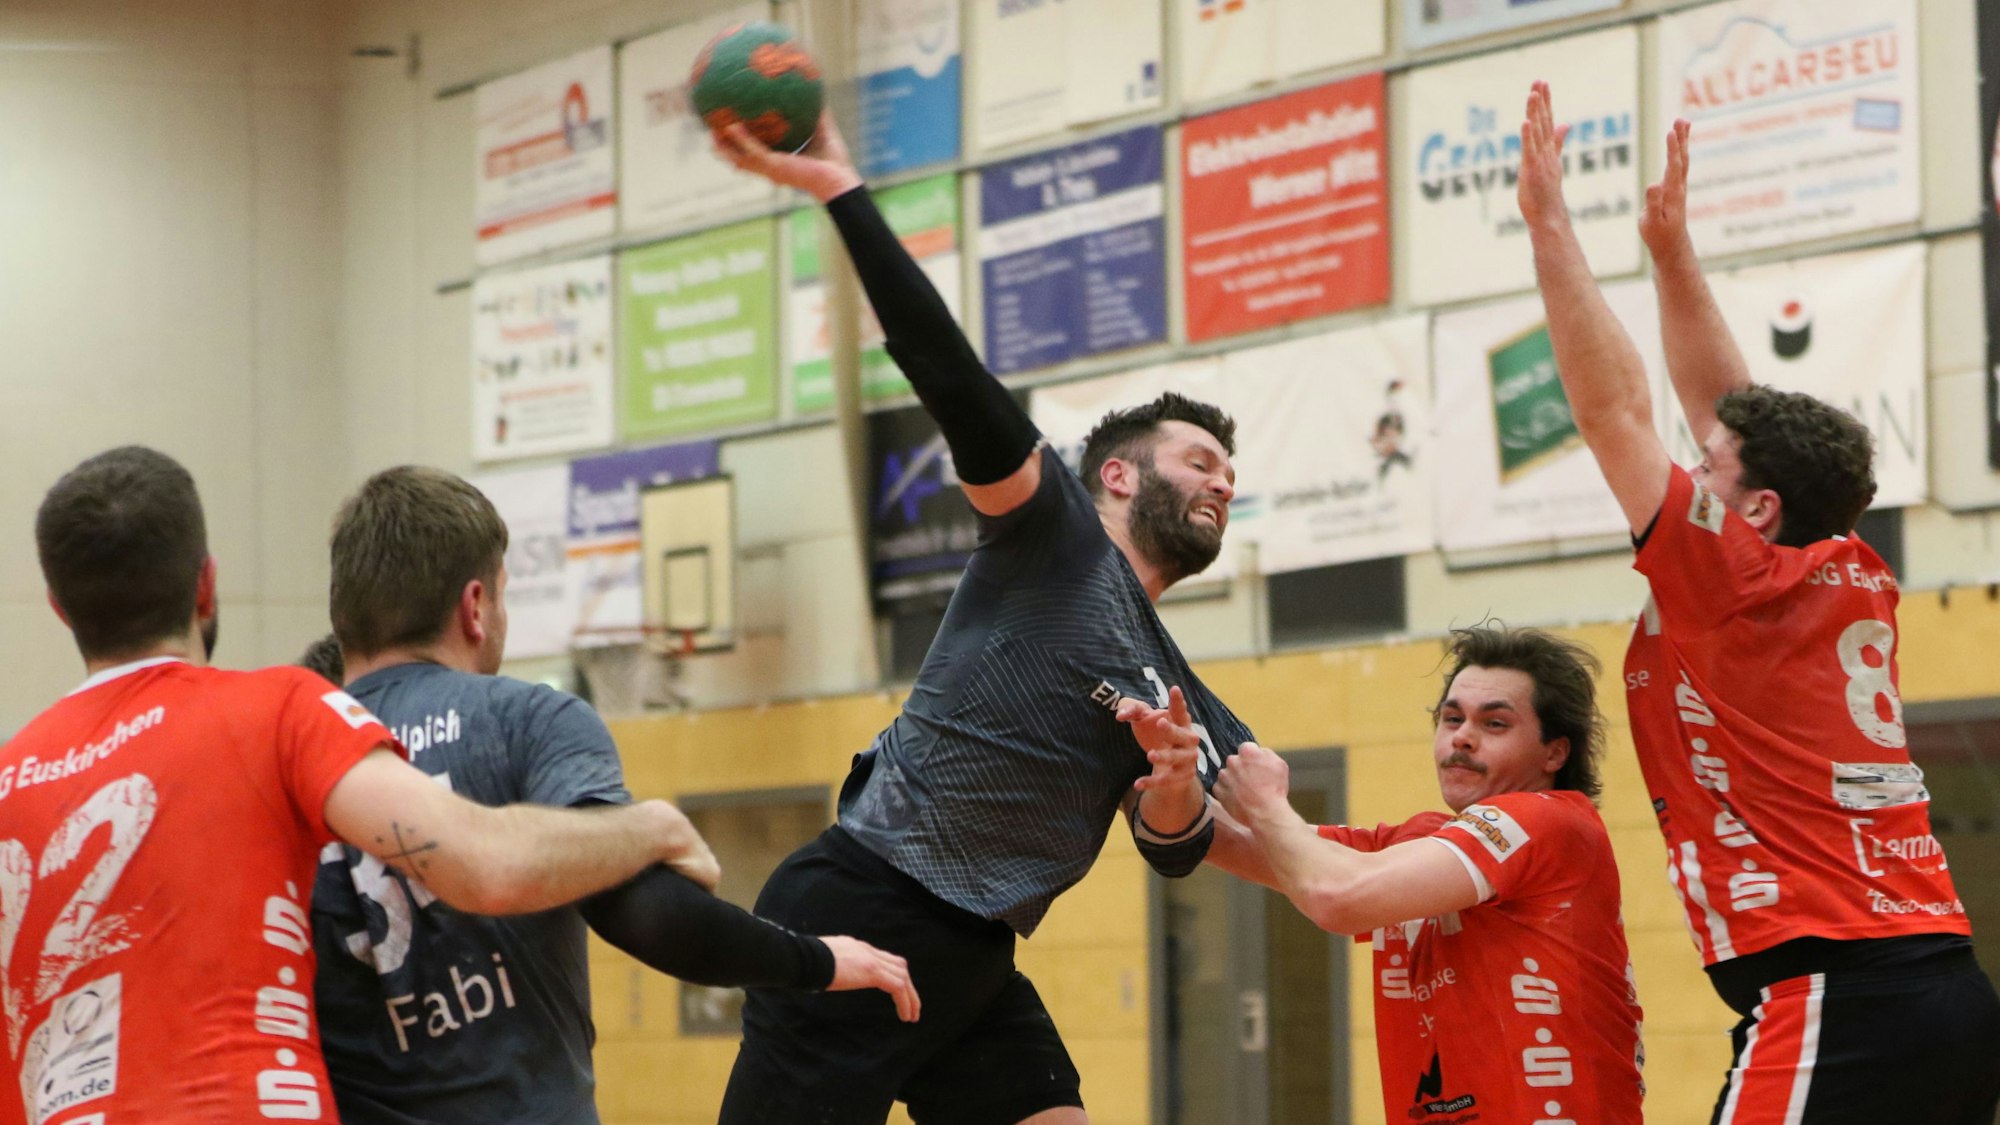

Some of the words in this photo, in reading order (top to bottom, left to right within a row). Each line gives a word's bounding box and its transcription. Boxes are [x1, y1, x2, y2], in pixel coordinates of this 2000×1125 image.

[1836, 618, 1906, 749] 8
[16, 705, 165, 789] Euskirchen
[390, 709, 461, 762] lpich
[387, 953, 516, 1052] Fabi
